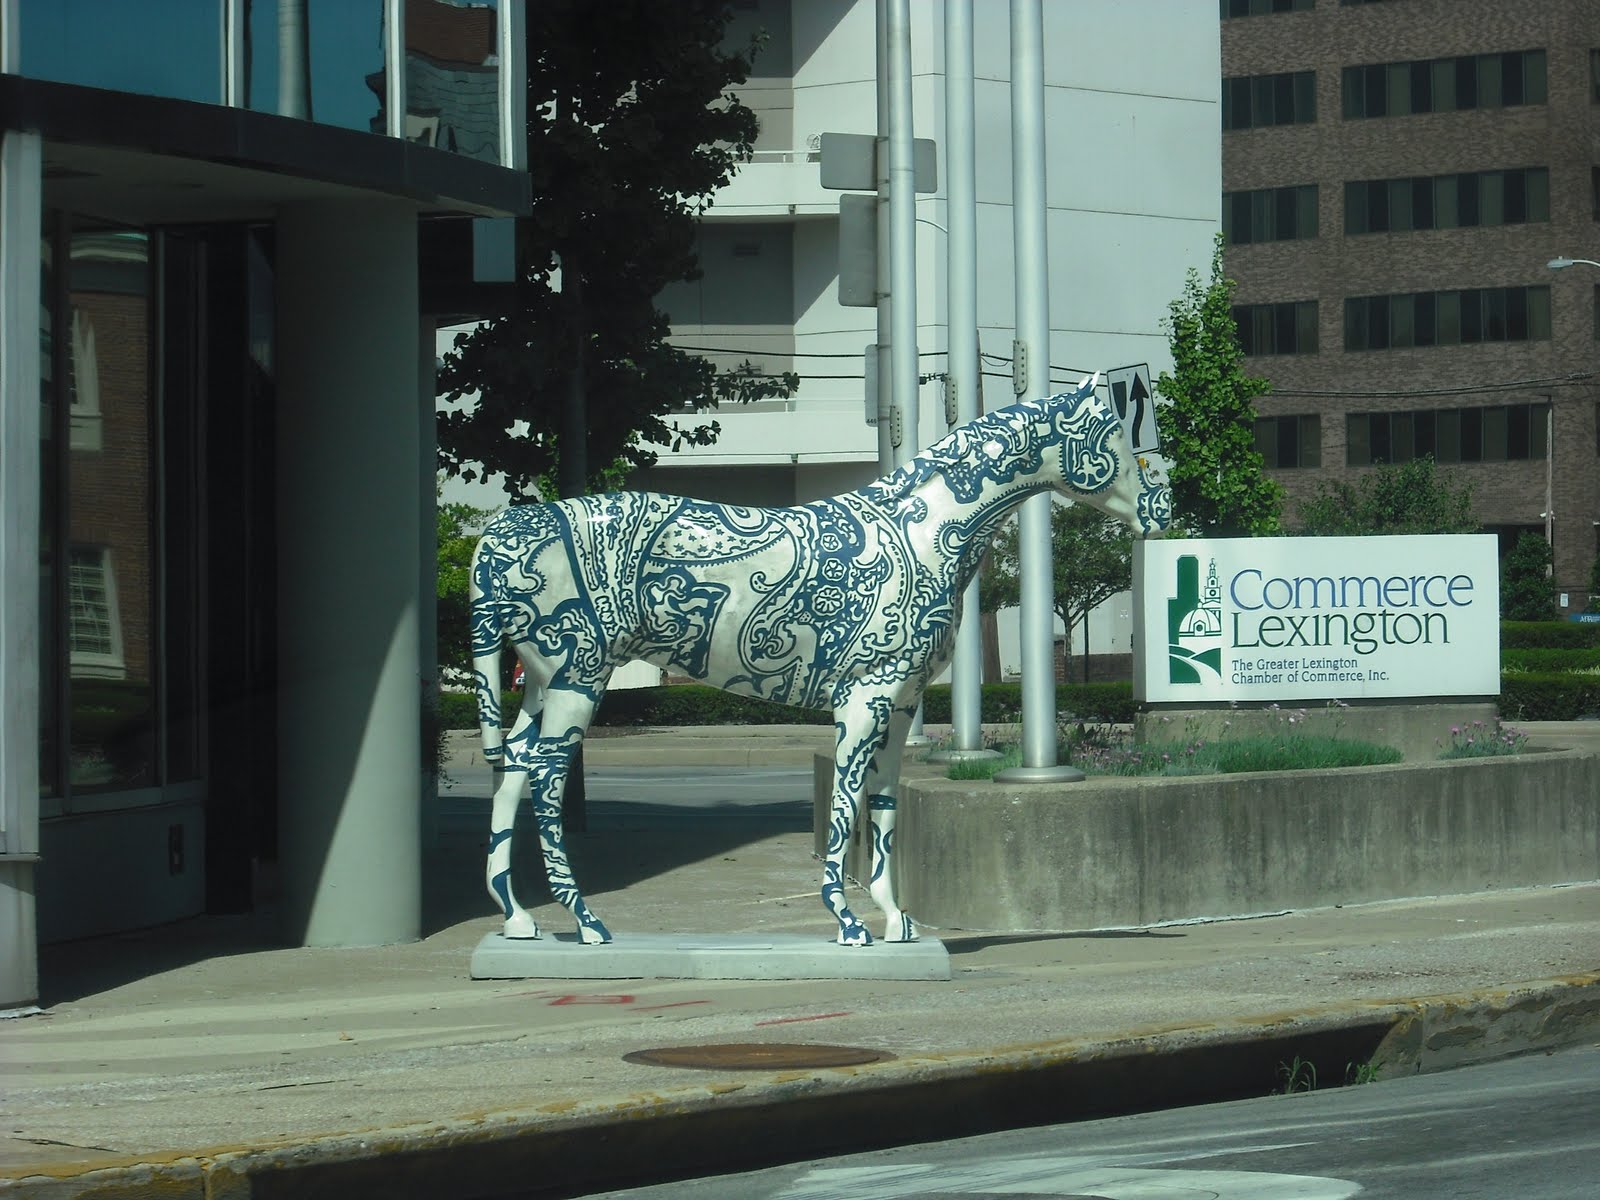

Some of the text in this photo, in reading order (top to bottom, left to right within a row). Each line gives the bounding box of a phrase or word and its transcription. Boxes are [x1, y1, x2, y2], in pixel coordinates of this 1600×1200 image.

[1230, 568, 1474, 611] Commerce
[1231, 609, 1450, 655] Lexington
[1231, 669, 1390, 685] Chamber of Commerce, Inc.
[1232, 657, 1358, 671] The Greater Lexington
